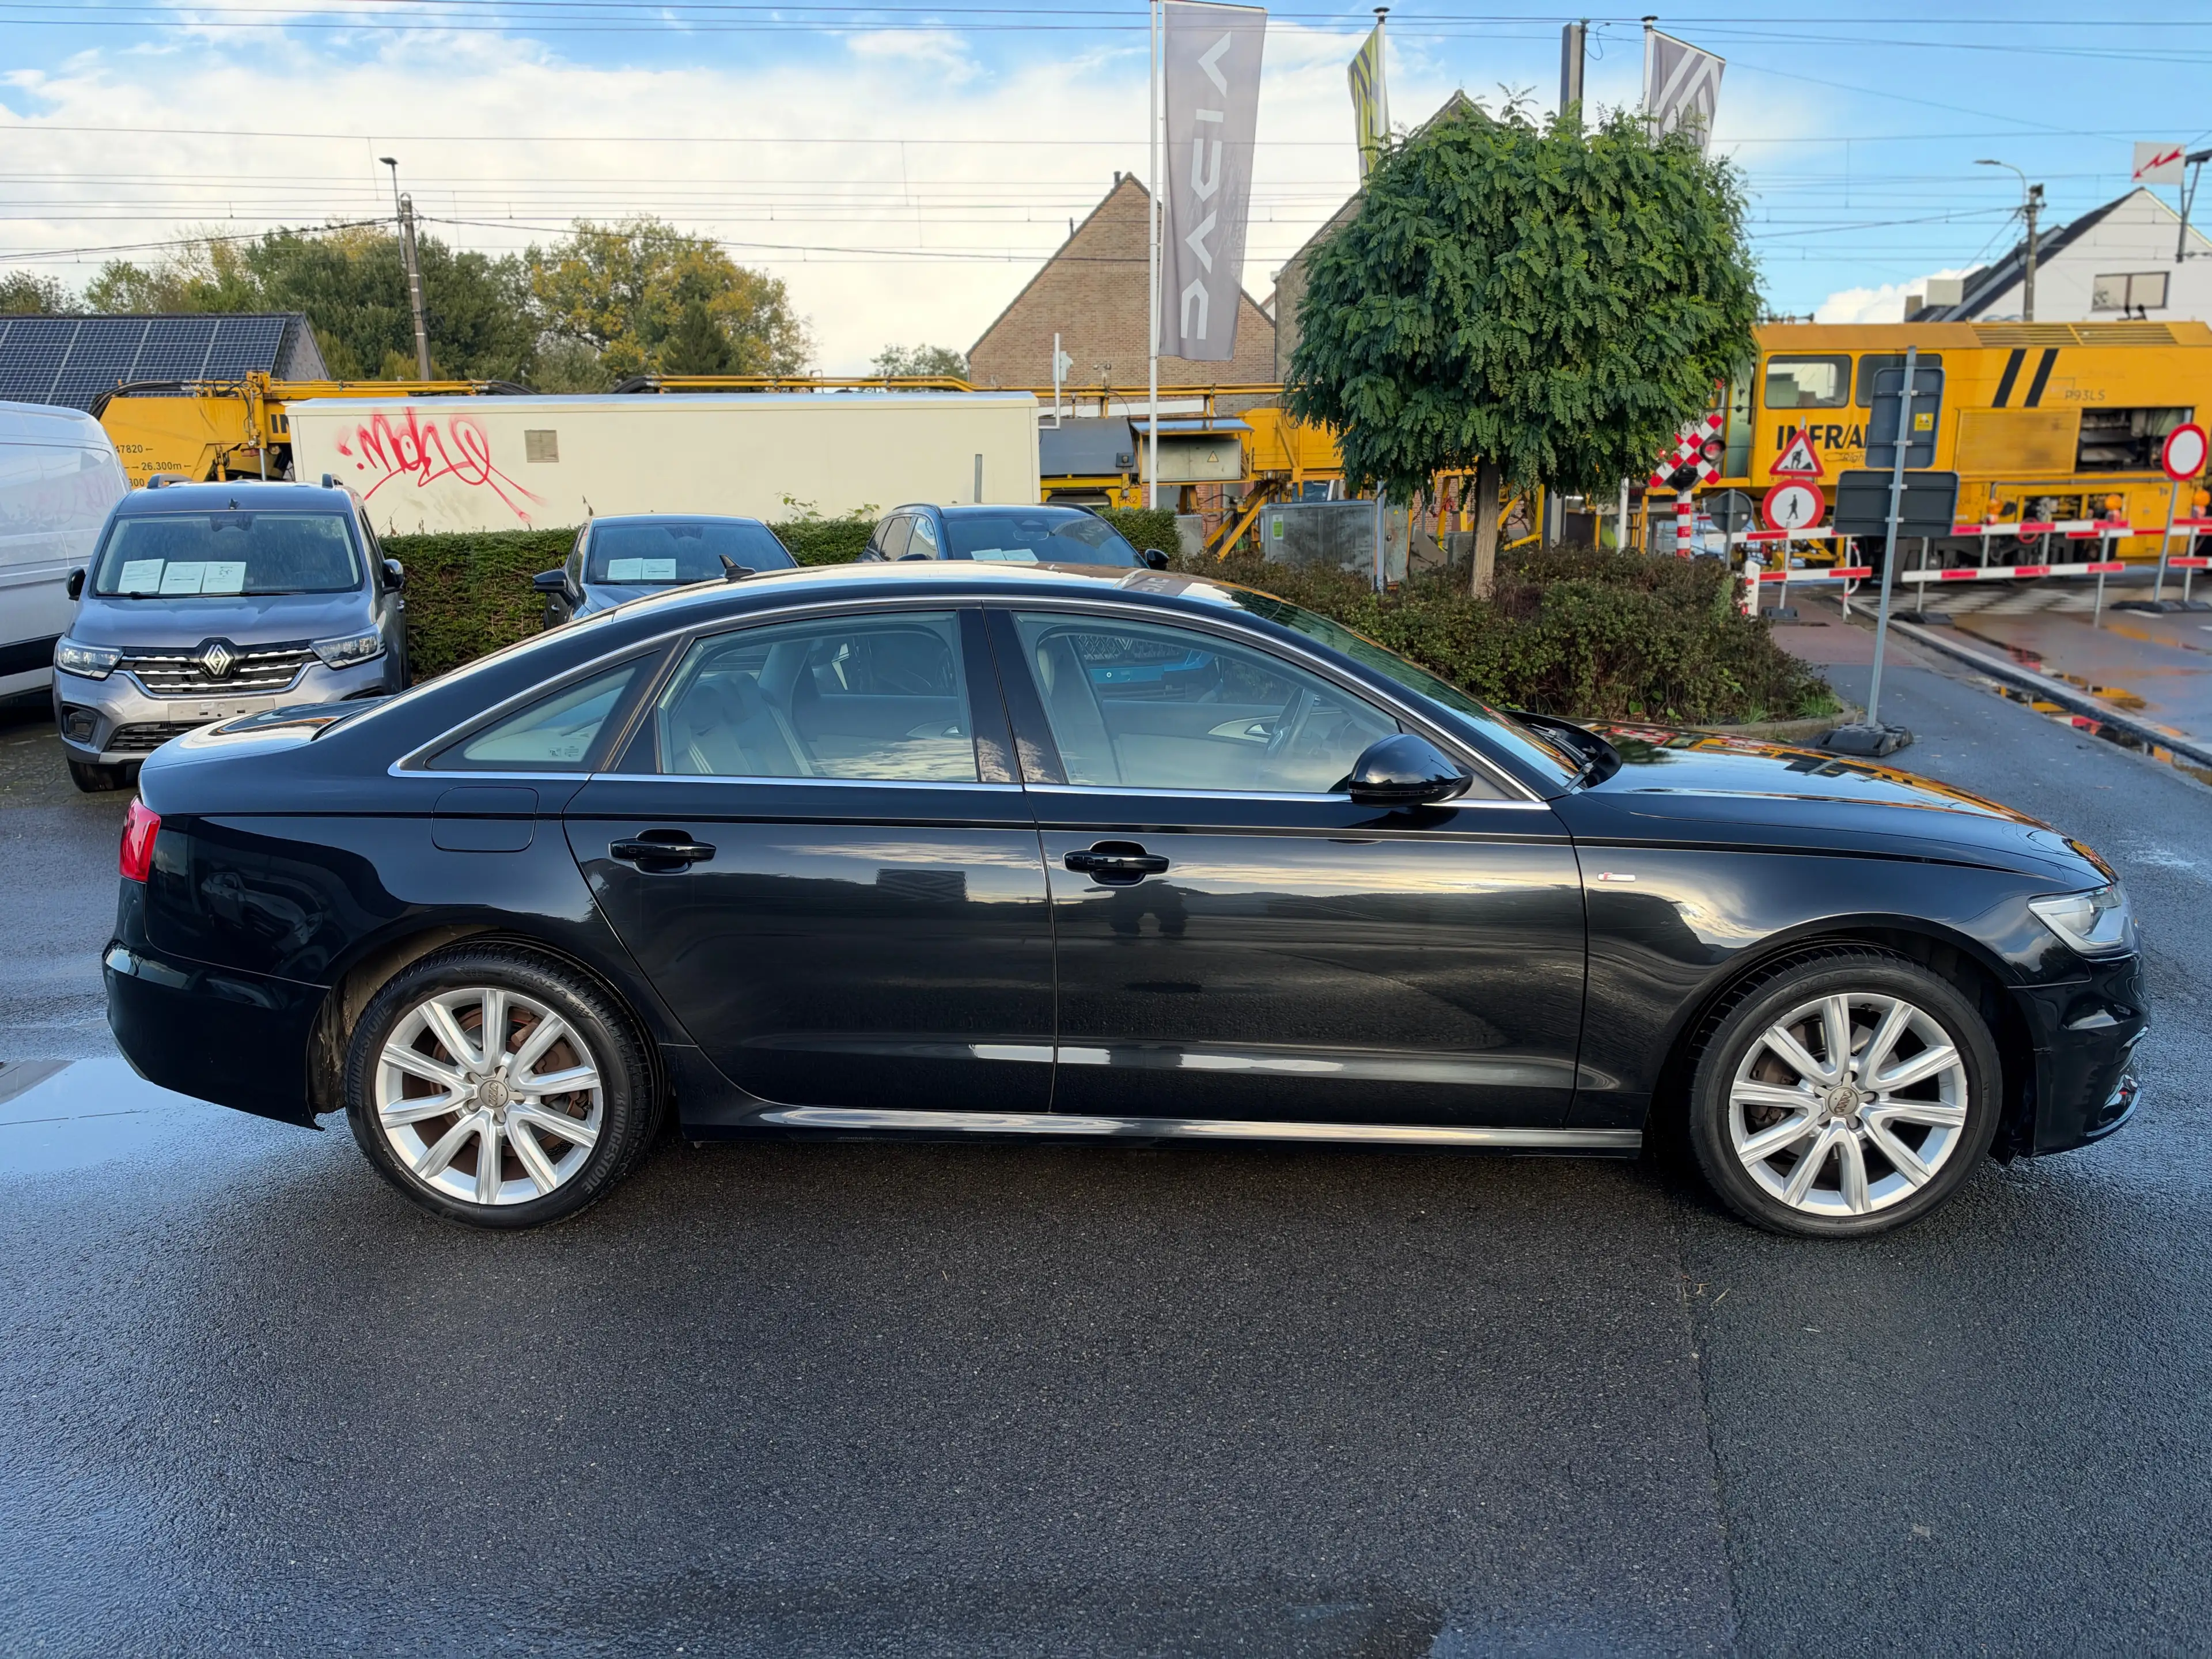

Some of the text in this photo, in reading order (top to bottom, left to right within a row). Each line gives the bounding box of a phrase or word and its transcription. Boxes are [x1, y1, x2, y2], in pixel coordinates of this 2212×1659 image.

[1181, 31, 1232, 340] DACIA
[141, 461, 182, 471] 26.300m
[349, 1004, 392, 1109] BRIDGESTONE
[581, 1090, 627, 1195] BRIDGESTONE
